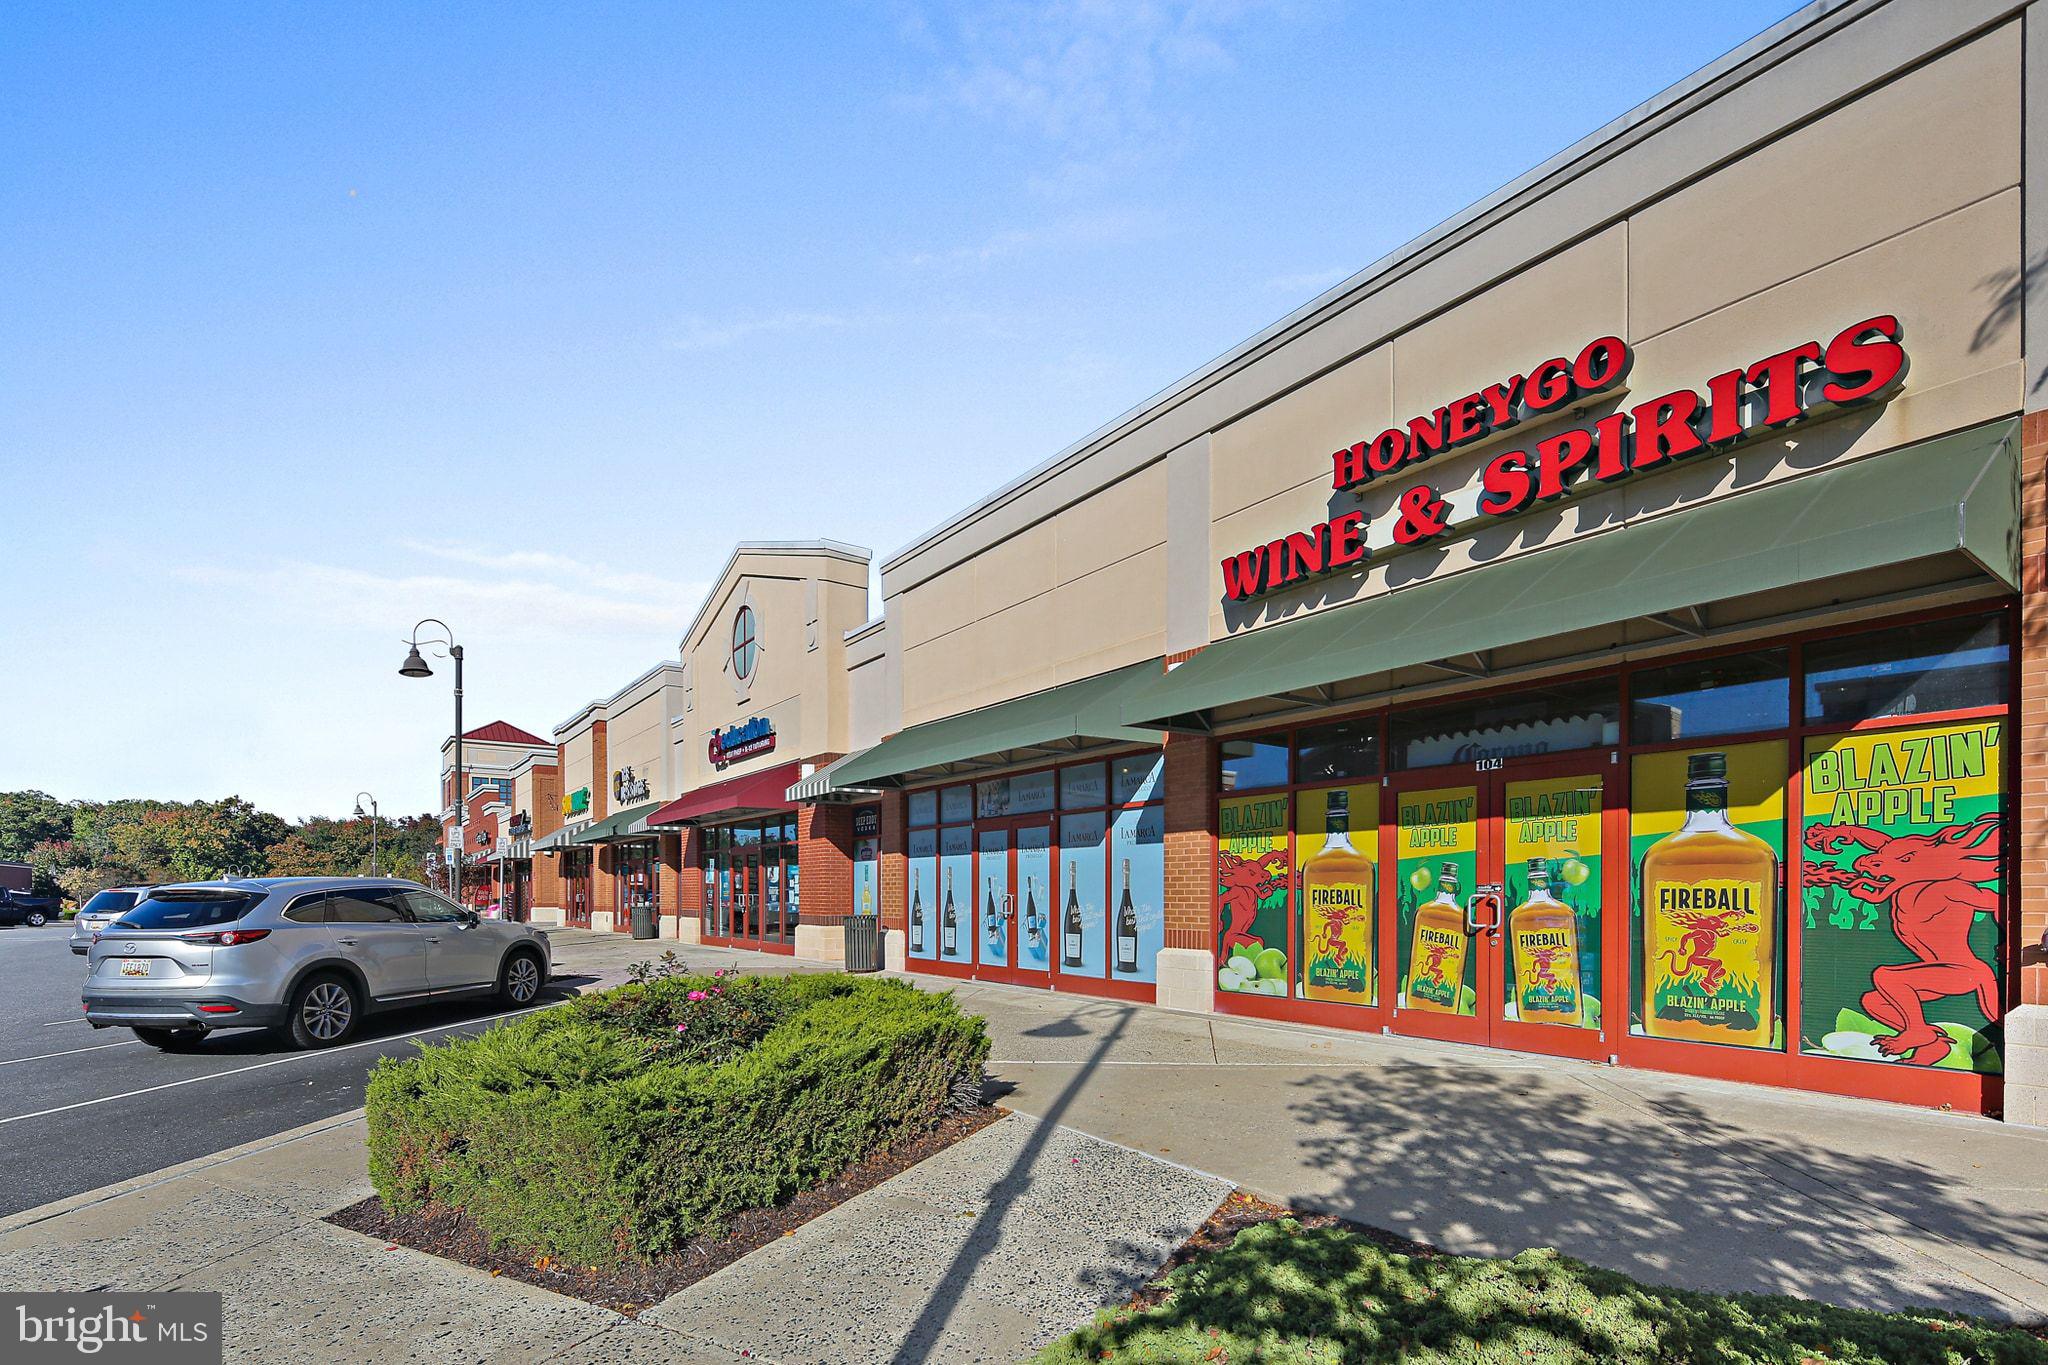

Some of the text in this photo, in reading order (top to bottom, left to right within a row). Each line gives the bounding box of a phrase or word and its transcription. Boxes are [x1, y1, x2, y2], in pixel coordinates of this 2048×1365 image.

[1331, 336, 1631, 490] HONEYGO
[1221, 314, 1905, 600] WINE & SPIRITS
[1477, 758, 1502, 771] 104
[1809, 725, 2001, 794] BLAZIN'
[1220, 797, 1288, 834] BLAZIN'
[1401, 797, 1474, 830] BLAZIN'
[1509, 787, 1597, 823] BLAZIN'
[1830, 786, 1956, 827] APPLE
[1229, 831, 1274, 854] APPLE
[1409, 827, 1457, 848] APPLE
[1519, 820, 1578, 843] APPLE
[1312, 889, 1363, 908] FIREBALL
[1660, 888, 1755, 915] FIREBALL
[1420, 929, 1460, 949] FIREBALL
[1520, 932, 1568, 947] FIREBALL
[1315, 967, 1359, 979] BLAZIN' APPLE
[1435, 989, 1450, 998] APPLE
[1550, 995, 1569, 1003] APPLE
[1667, 995, 1708, 1009] BLAZIN'
[1710, 998, 1746, 1012] APPLE
